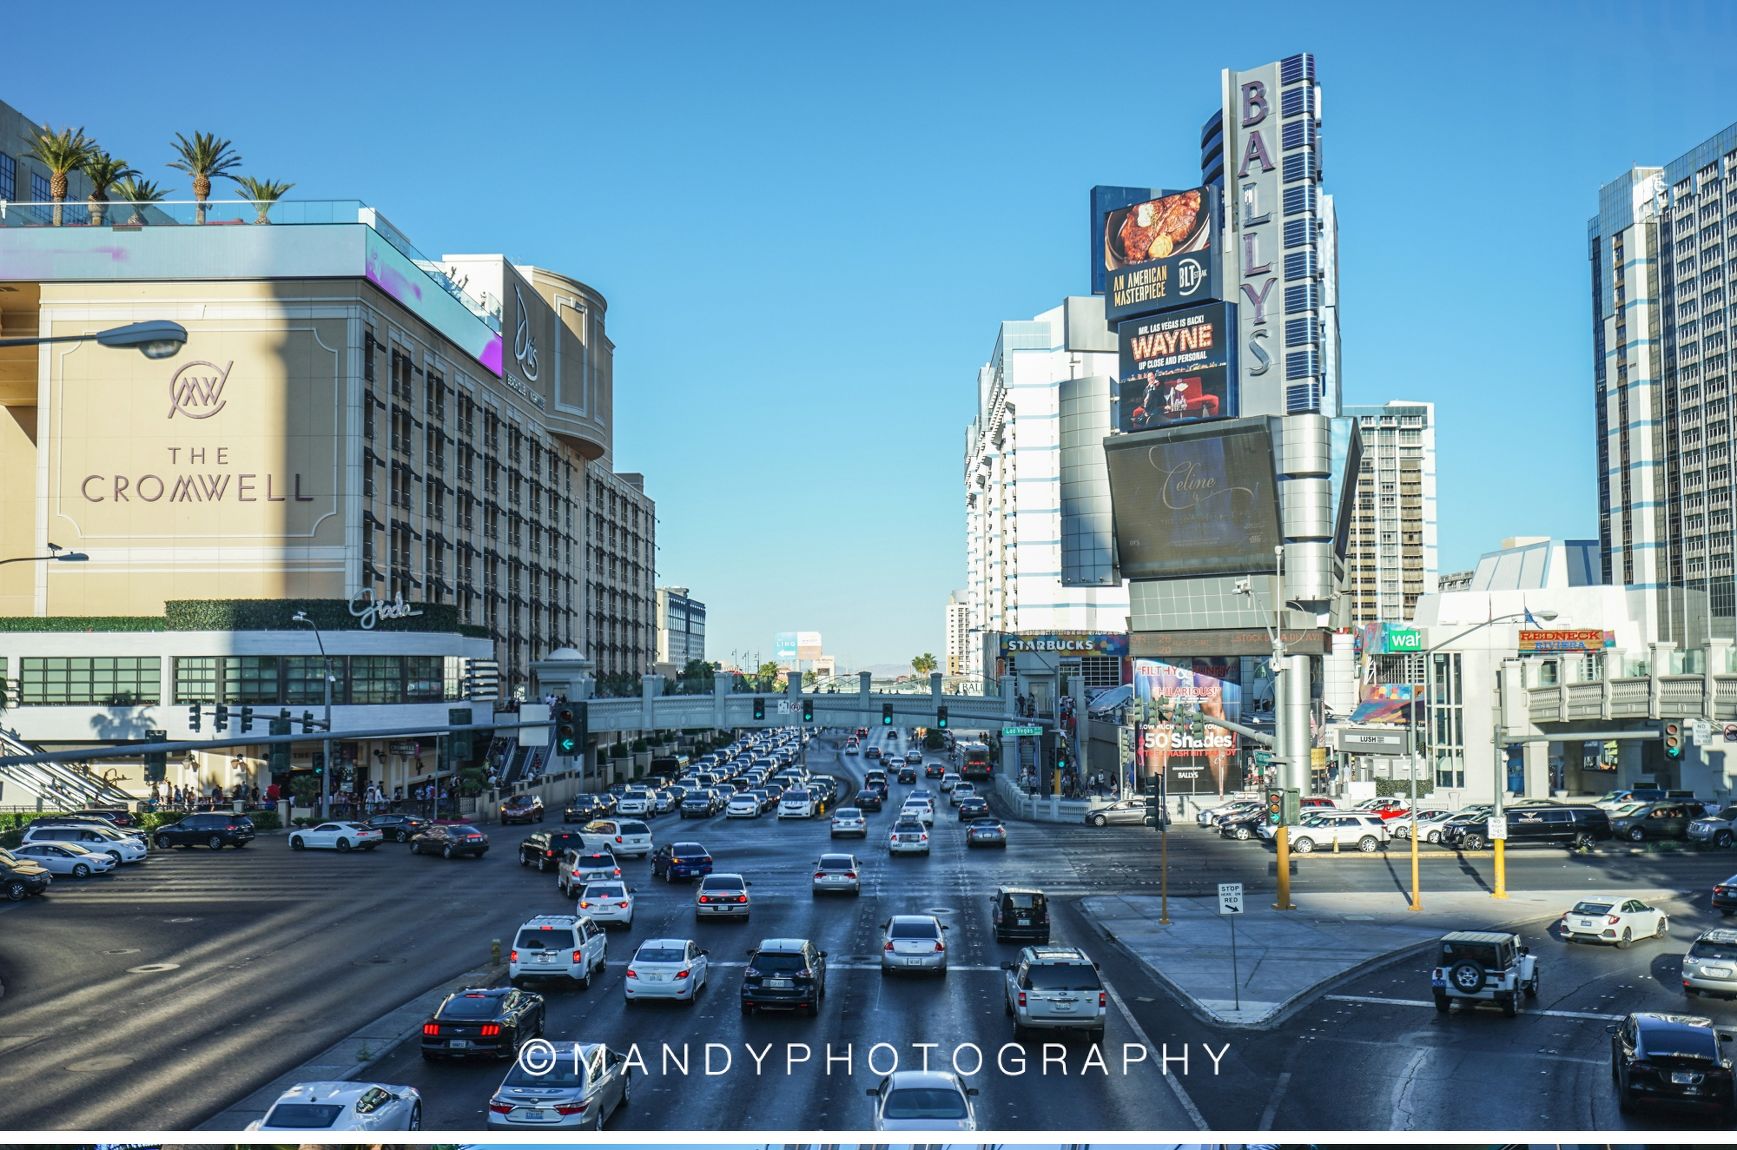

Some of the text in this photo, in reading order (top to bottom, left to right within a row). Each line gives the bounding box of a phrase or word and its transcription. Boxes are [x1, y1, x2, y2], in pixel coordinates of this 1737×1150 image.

[1113, 265, 1168, 292] AN AMERICAN
[1179, 264, 1196, 289] BLT
[1114, 281, 1167, 307] MASTERPIECE
[1138, 315, 1205, 335] MR. LAS VEGAS IS BACK!
[1130, 323, 1213, 361] WAYNE
[1138, 351, 1208, 371] UP CLOSE AND PERSONAL
[167, 447, 229, 465] THE
[81, 473, 315, 503] CROMWELL
[1520, 630, 1601, 641] REDNECK
[1008, 640, 1095, 652] STARBUCKS
[1144, 732, 1168, 749] 50
